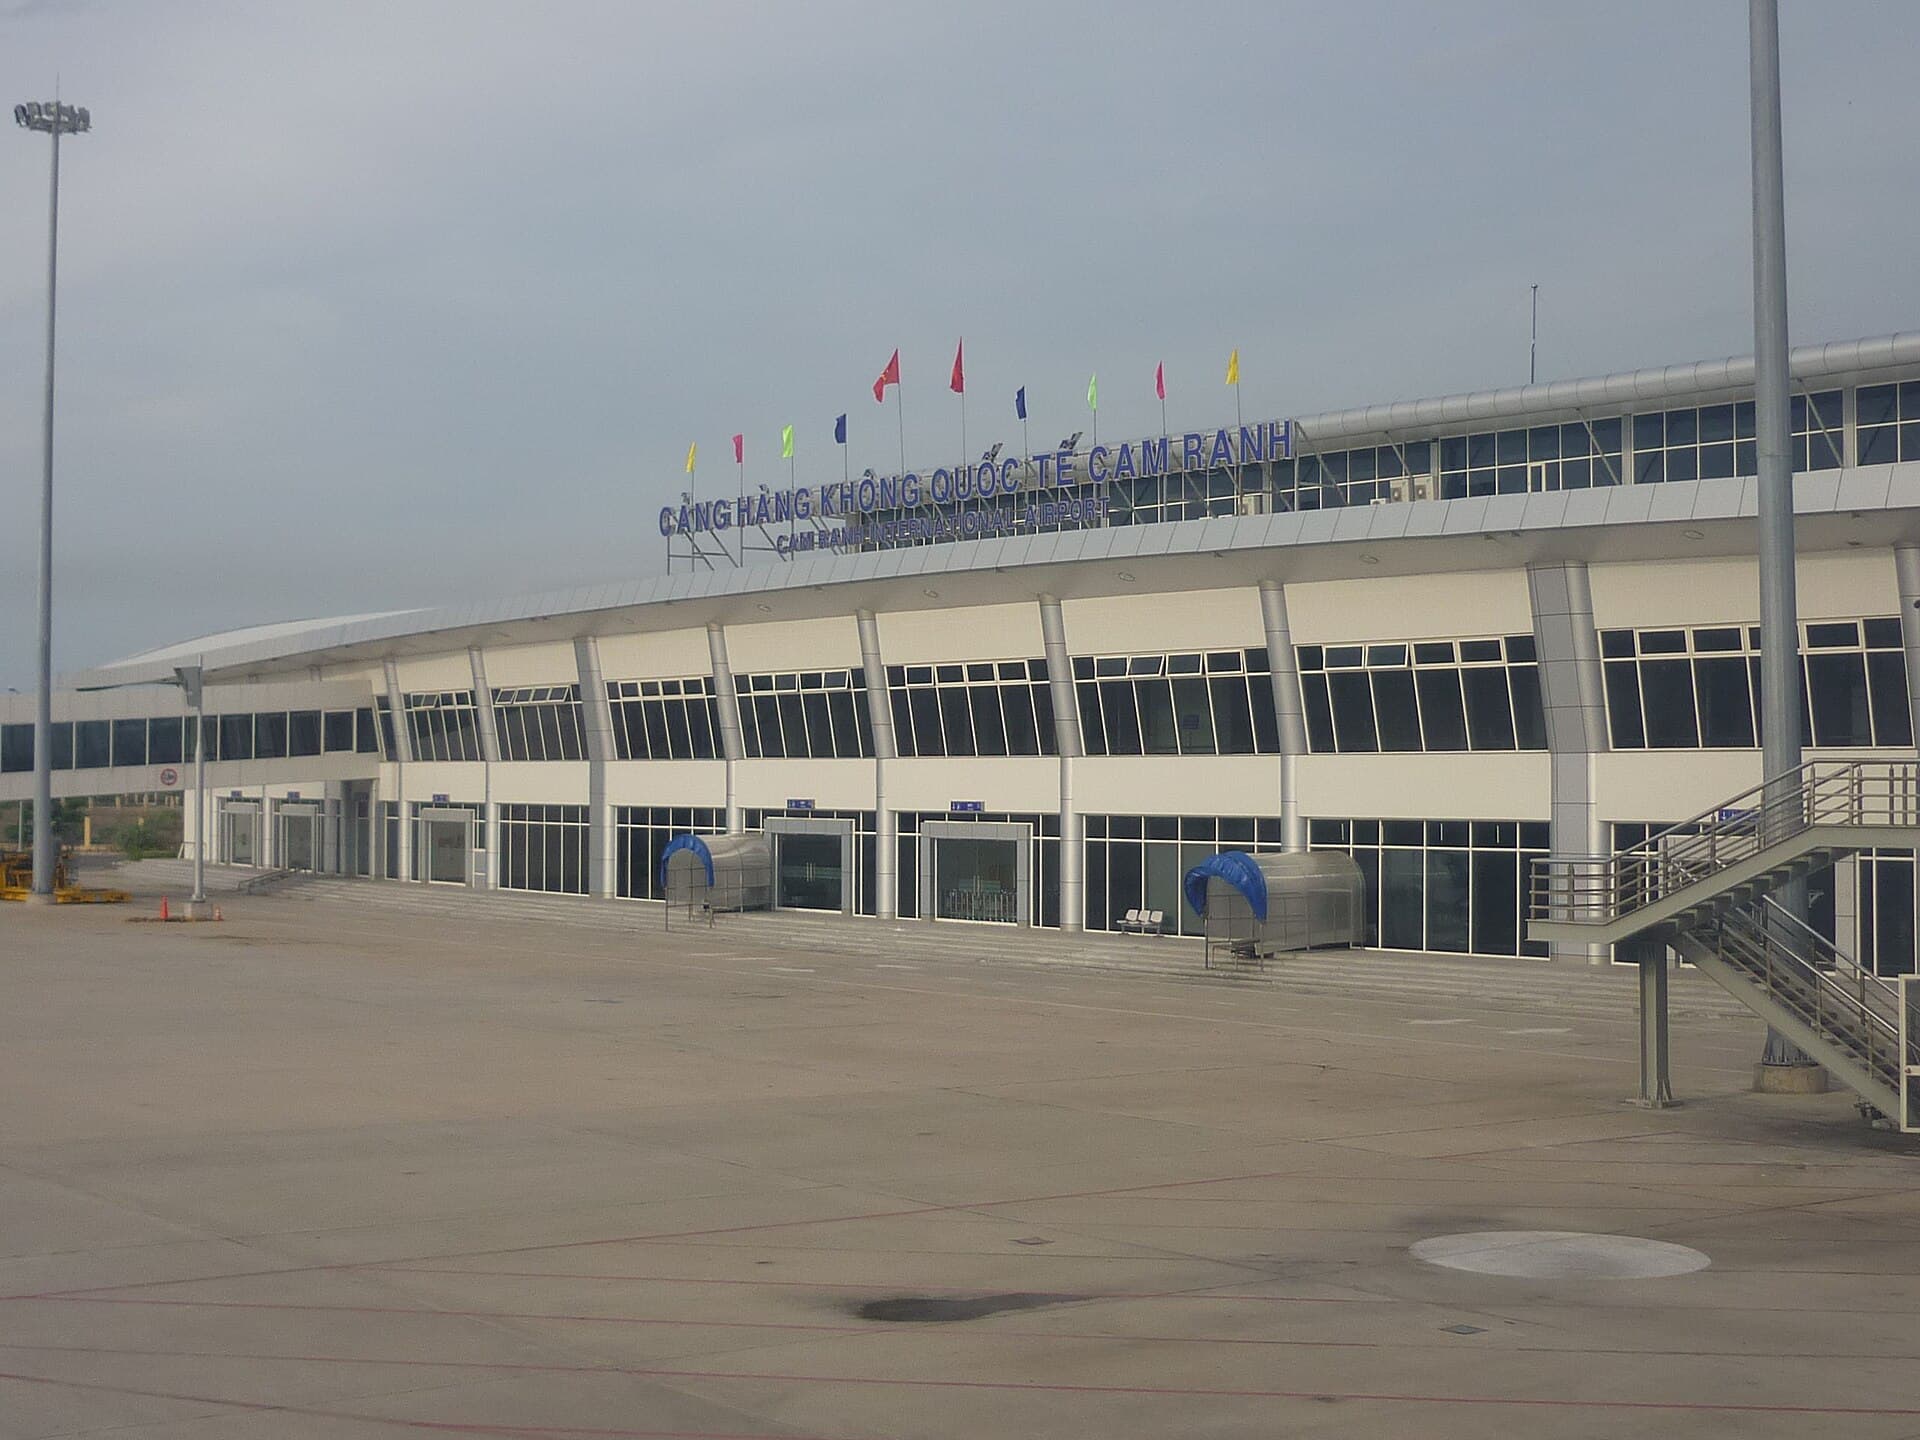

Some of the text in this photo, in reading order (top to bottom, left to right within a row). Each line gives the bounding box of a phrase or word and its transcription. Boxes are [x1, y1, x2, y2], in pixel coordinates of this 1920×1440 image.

[659, 419, 1292, 537] CẢNG HÀNG KHÔNG QUỐC TẾ CAM RANH
[776, 496, 1110, 554] CAM RANH INTERNATIONAL AIRPORT
